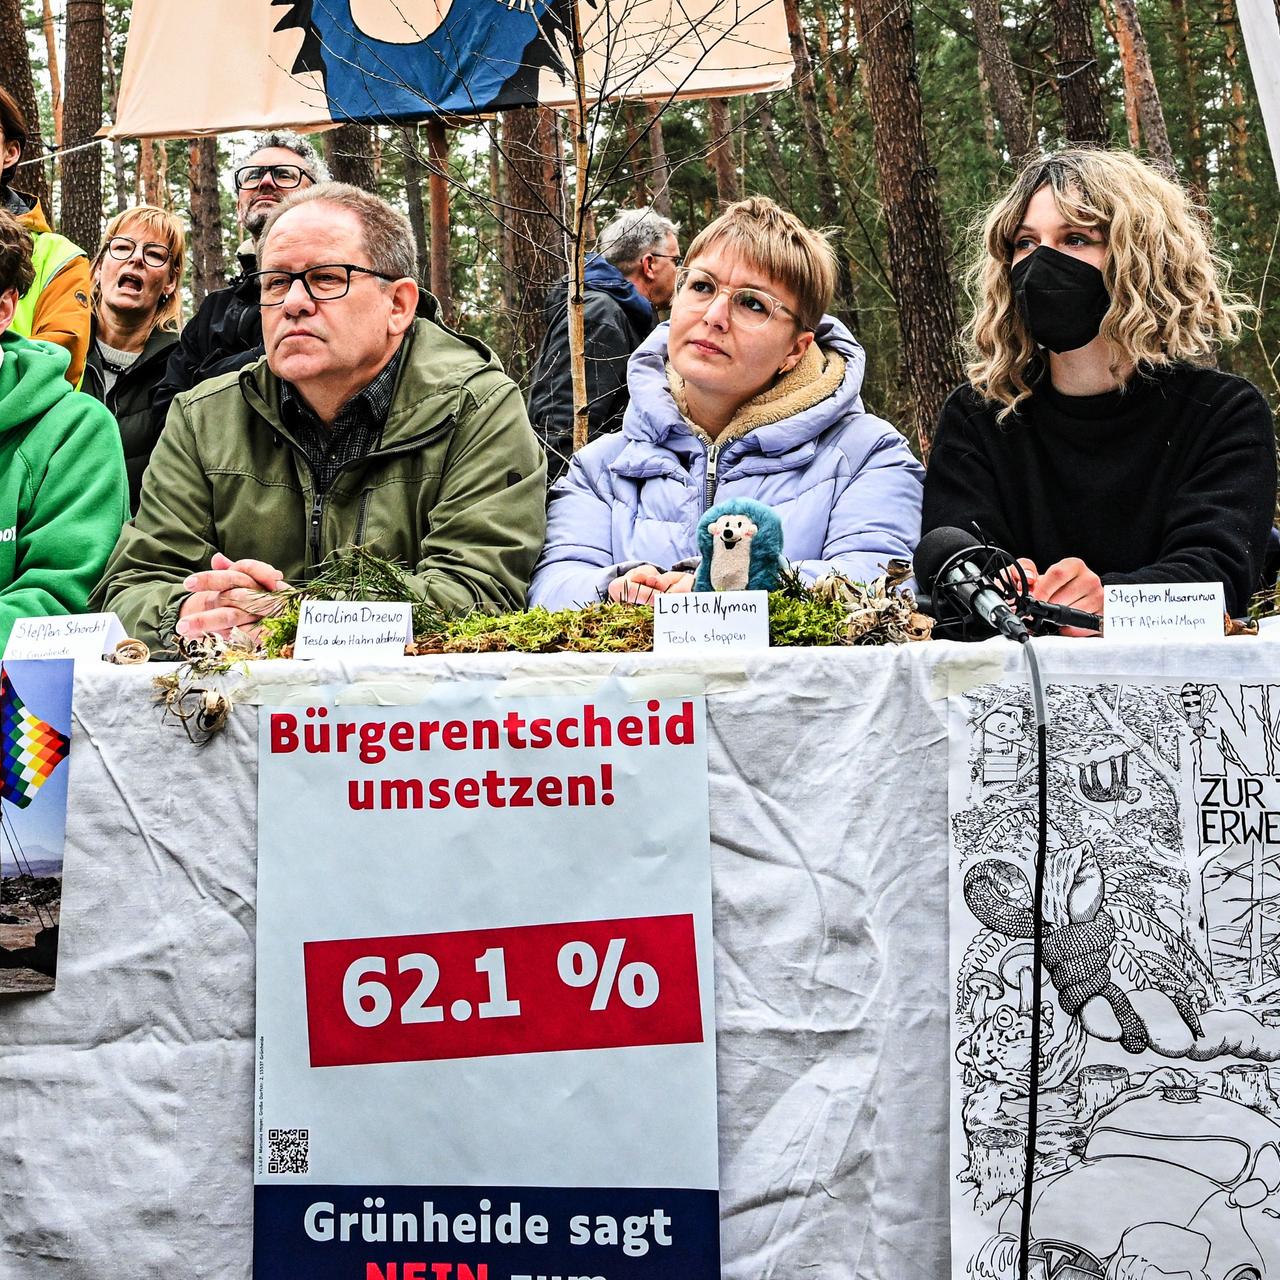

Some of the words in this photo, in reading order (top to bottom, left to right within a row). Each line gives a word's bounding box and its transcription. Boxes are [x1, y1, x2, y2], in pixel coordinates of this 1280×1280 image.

[659, 596, 710, 614] Lotta
[713, 595, 757, 621] Nyman
[1109, 589, 1160, 608] Stephen
[304, 606, 358, 624] Karolina
[303, 635, 329, 646] Tesla
[332, 635, 346, 646] den
[349, 634, 374, 646] Hahn
[663, 631, 696, 644] Tesla
[704, 628, 746, 645] stoppen
[270, 699, 695, 764] Bürgerentscheid
[348, 763, 615, 810] umsetzen!
[1200, 778, 1267, 809] ZUR
[341, 946, 521, 1028] 62.1
[557, 938, 660, 1012] %
[303, 1197, 549, 1246] Grünheide
[569, 1209, 673, 1257] sagt
